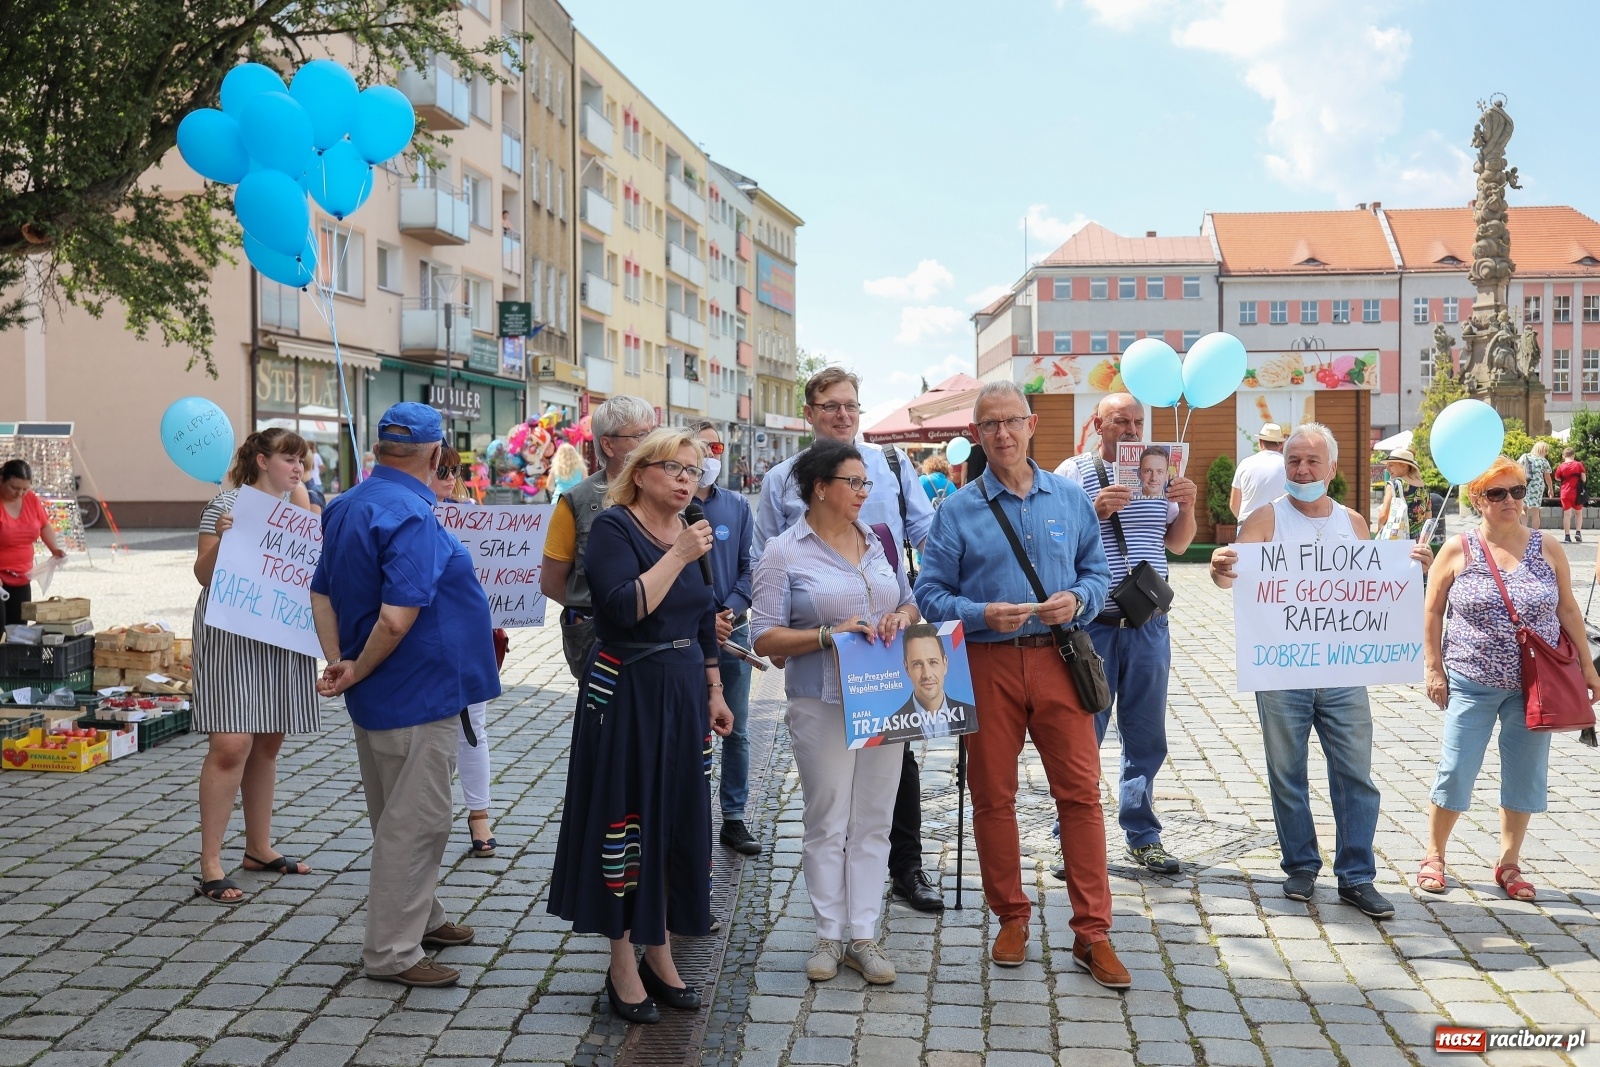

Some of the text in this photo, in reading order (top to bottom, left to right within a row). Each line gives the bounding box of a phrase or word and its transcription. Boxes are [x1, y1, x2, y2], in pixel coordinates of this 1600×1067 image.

[256, 359, 335, 406] STELLA
[173, 430, 185, 444] NA
[928, 430, 960, 439] Gelateria
[495, 511, 541, 532] DAMA
[260, 530, 281, 554] NA
[479, 540, 530, 558] STAŁA
[1260, 543, 1288, 572] NA
[211, 568, 263, 616] RAFAŁ
[1295, 578, 1409, 602] GŁOSUJEMY
[1283, 605, 1391, 632] RAFAŁOWI
[1252, 642, 1320, 667] DOBRZE
[847, 670, 900, 684] Silny Prezydent
[848, 680, 903, 695] Wspólna Polska
[852, 710, 872, 719] RAFAŁ
[852, 706, 965, 736] TRZASKOWSKI
